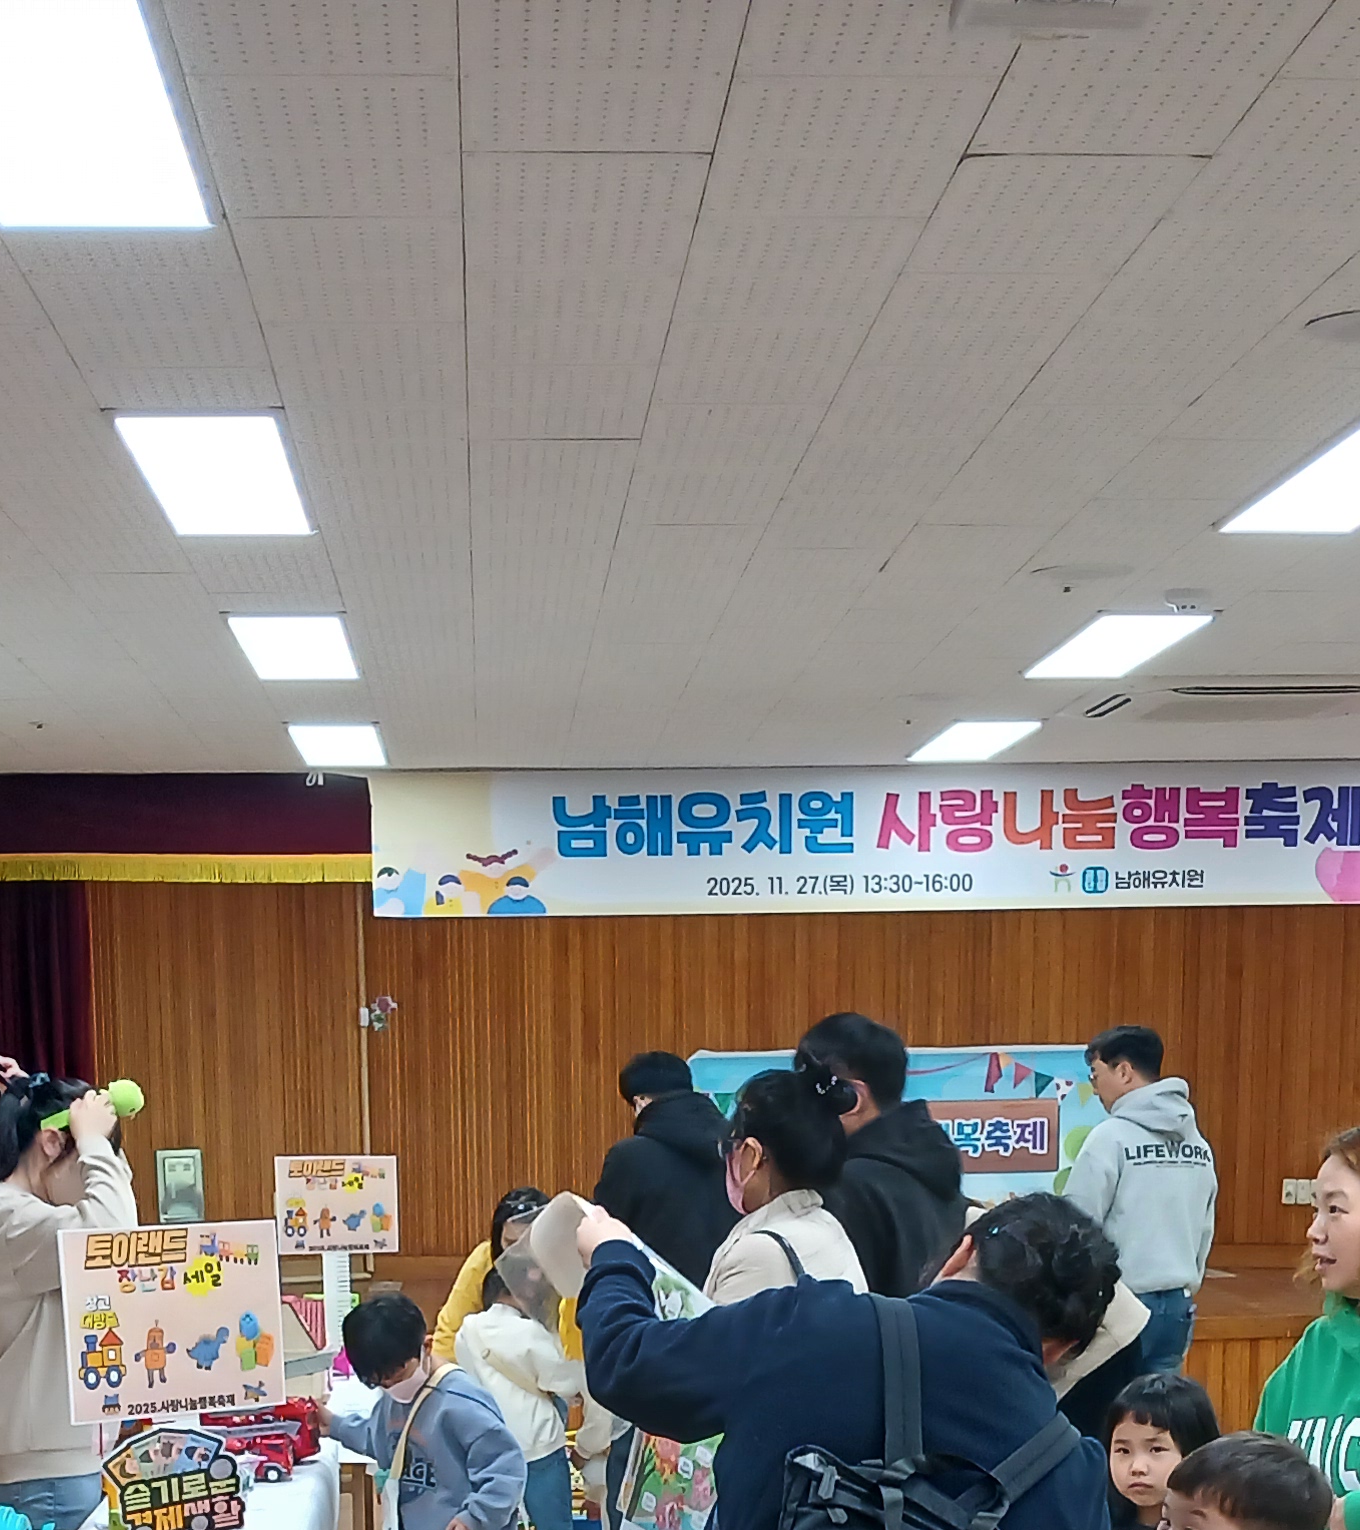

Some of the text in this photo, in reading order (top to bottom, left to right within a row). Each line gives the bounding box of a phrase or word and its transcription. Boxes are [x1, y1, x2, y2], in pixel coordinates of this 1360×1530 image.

[552, 790, 855, 858] 남해유치원
[706, 877, 759, 896] 2025.
[767, 876, 789, 895] 11.
[863, 872, 973, 894] 13:30~16:00
[1114, 869, 1205, 891] 남해유치원
[943, 1119, 1047, 1155] 복축제
[1124, 1141, 1211, 1162] LIFEWORK
[84, 1228, 189, 1270] 토이랜드
[117, 1260, 222, 1294] 장난감 세일
[123, 1458, 238, 1511] 슬기로운
